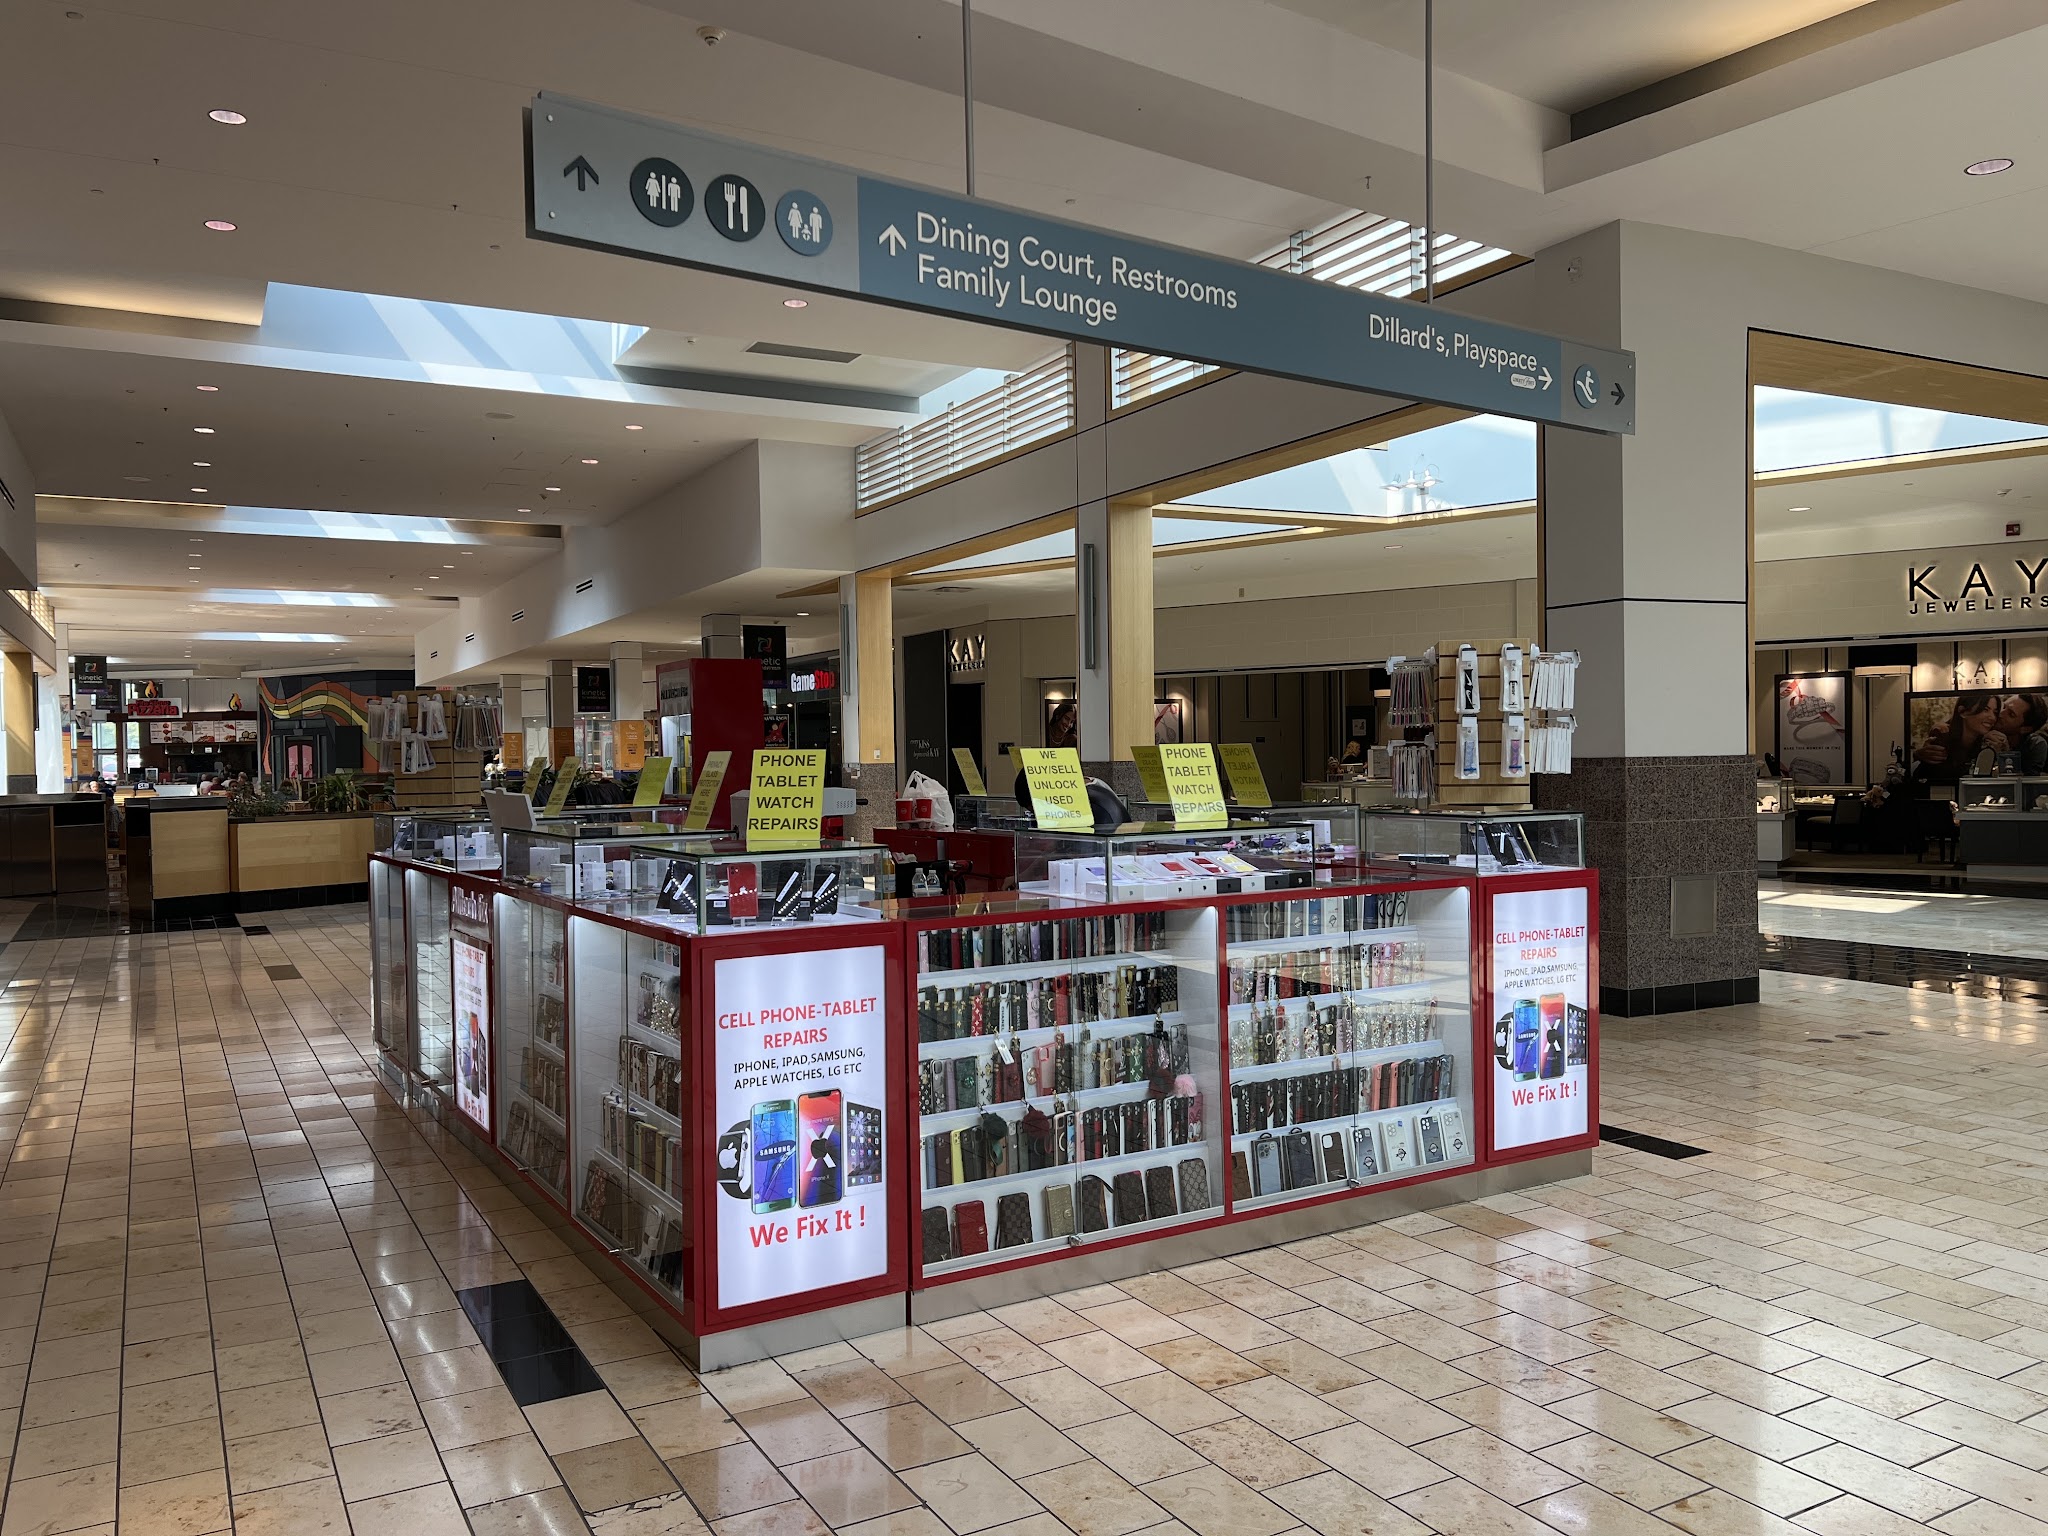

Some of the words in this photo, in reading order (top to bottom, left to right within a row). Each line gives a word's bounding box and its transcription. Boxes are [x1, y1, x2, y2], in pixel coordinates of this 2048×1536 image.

[917, 211, 1009, 268] Dining
[1019, 236, 1102, 285] Court,
[1111, 256, 1238, 309] Restrooms
[918, 253, 1011, 308] Family
[1020, 275, 1118, 326] Lounge
[1369, 313, 1450, 358] Dillard's,
[1454, 333, 1537, 372] Playspace
[1909, 558, 2048, 601] KAY
[1909, 595, 2048, 615] JEWELERS
[949, 634, 985, 663] KAY
[790, 669, 836, 693] GameStop
[128, 703, 178, 716] Pizzeria
[1039, 750, 1057, 759] WE
[1165, 748, 1207, 759] PHONE
[760, 754, 816, 767] PHONE
[1027, 765, 1077, 775] BUY/SELL
[1167, 766, 1212, 777] TABLET
[756, 775, 818, 788] TABLET
[1034, 780, 1078, 790] UNLOCK
[1173, 784, 1215, 795] WATCH
[757, 796, 814, 808] WATCH
[1045, 796, 1074, 805] USED
[1174, 802, 1224, 814] REPAIRS
[1045, 811, 1082, 819] PHONES
[748, 818, 818, 830] REPAIRS
[1496, 932, 1517, 944] CELL
[1519, 926, 1585, 942] PHONE-TABLET
[1520, 947, 1557, 960] REPAIRS
[1504, 967, 1530, 977] IPHONE,
[1504, 980, 1523, 989] APPLE
[1525, 976, 1556, 987] WATCHES,
[1556, 975, 1564, 983] LG
[1566, 974, 1576, 982] ETC
[719, 1012, 755, 1029] CELL
[760, 997, 877, 1025] PHONE-TABLET
[764, 1027, 828, 1049] REPAIRS
[734, 1058, 779, 1074] IPHONE,
[734, 1075, 768, 1090] APPLE
[771, 1067, 825, 1084] WATCHES,
[828, 1066, 841, 1076] LG
[844, 1063, 862, 1075] ETC
[1512, 1088, 1534, 1106] We
[1539, 1085, 1556, 1102] Fix
[1560, 1082, 1570, 1098] It
[760, 1145, 791, 1157] SAMSUNG
[749, 1222, 788, 1248] We
[797, 1214, 828, 1239] Fix
[835, 1209, 852, 1232] It
